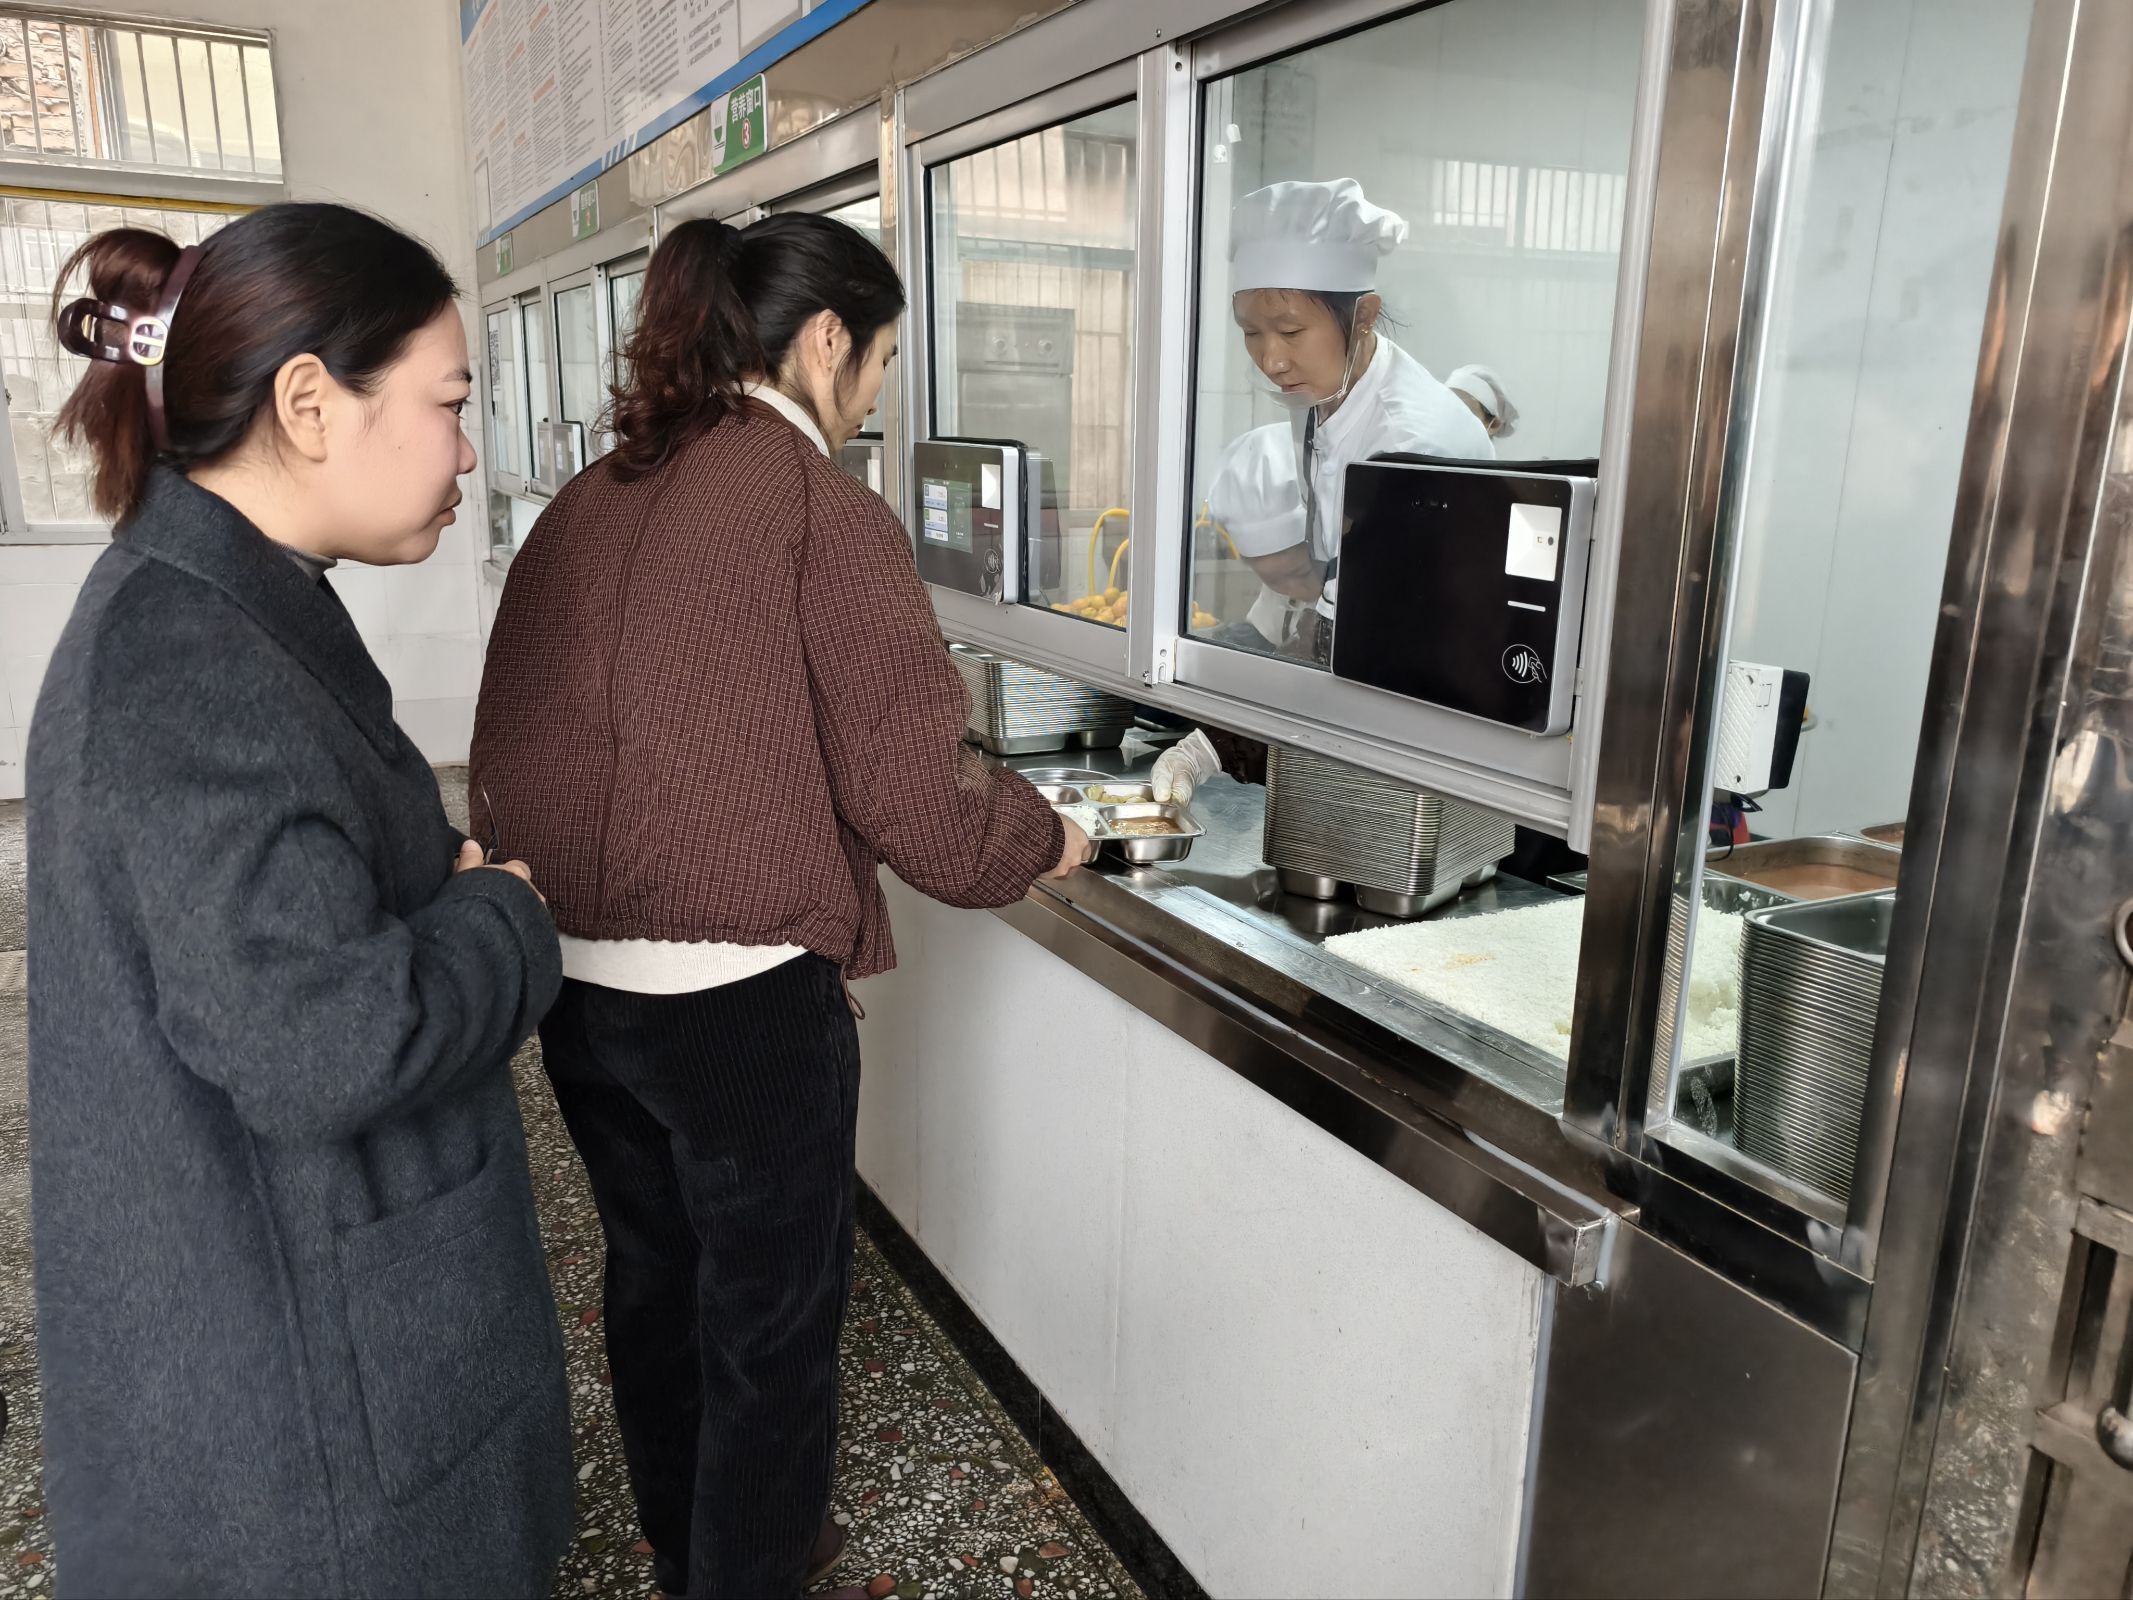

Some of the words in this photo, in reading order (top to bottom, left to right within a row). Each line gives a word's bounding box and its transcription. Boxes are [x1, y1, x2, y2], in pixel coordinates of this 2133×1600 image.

[731, 86, 762, 123] 营养窗口
[743, 122, 750, 145] 3
